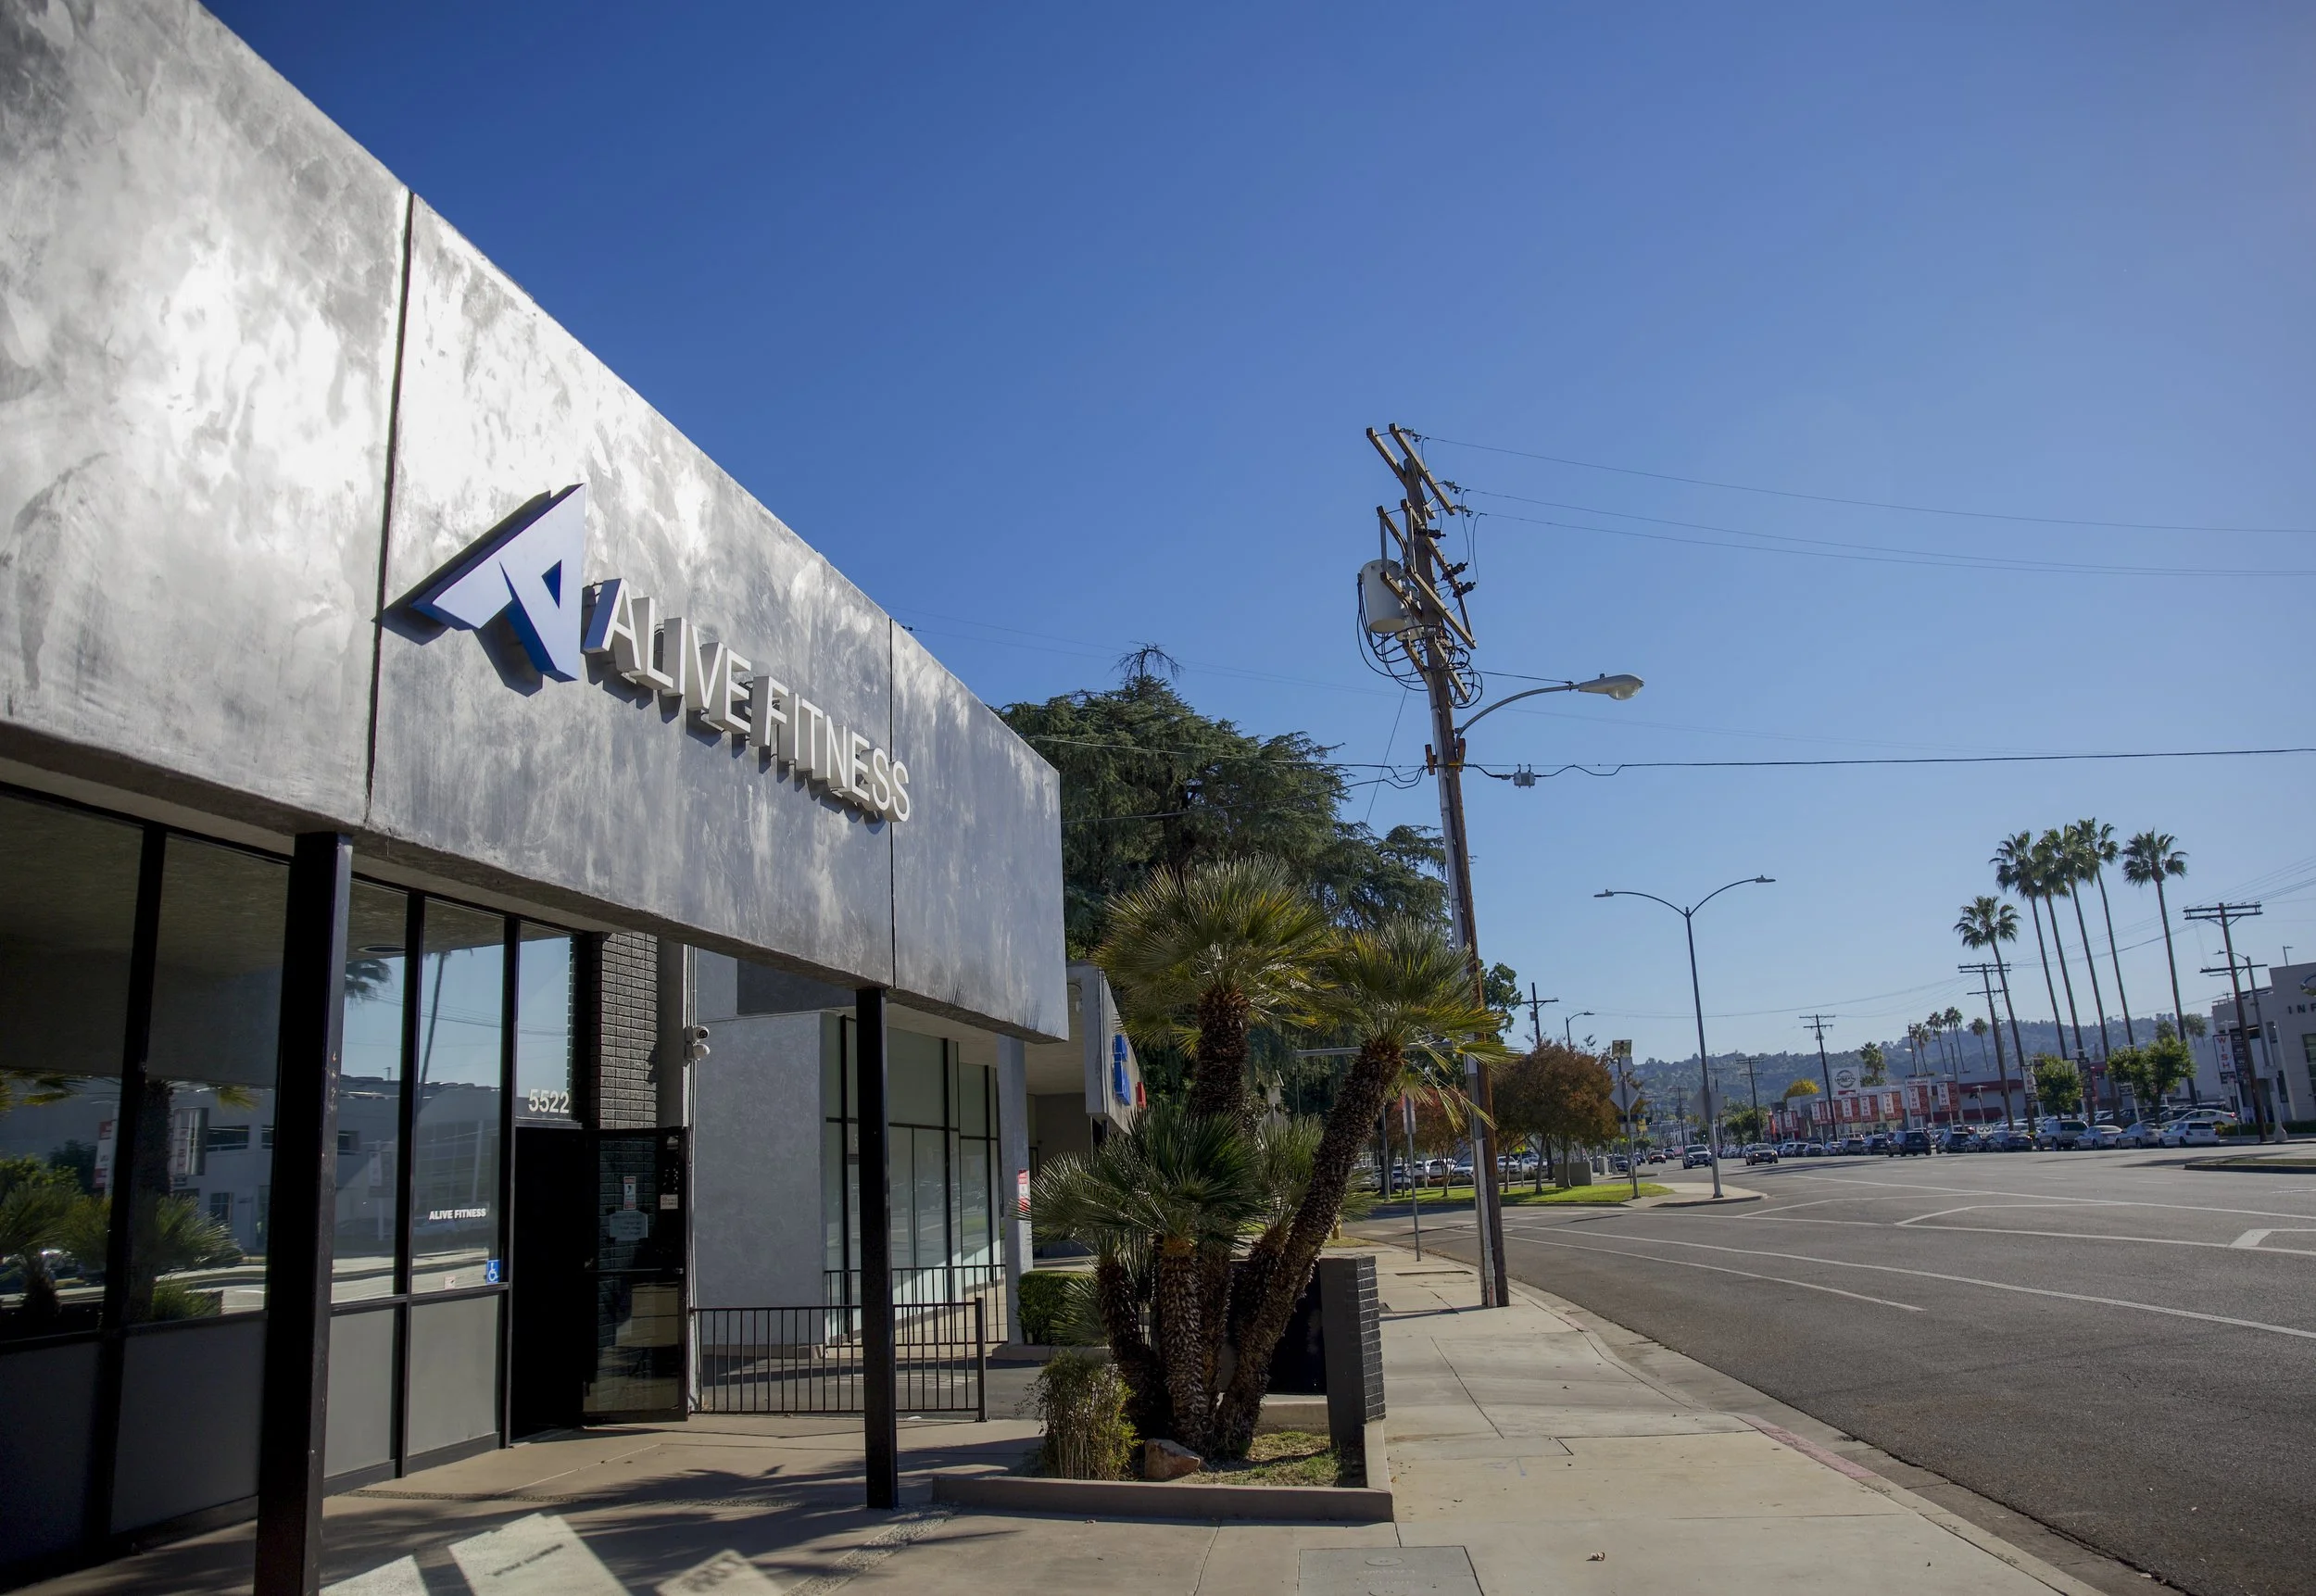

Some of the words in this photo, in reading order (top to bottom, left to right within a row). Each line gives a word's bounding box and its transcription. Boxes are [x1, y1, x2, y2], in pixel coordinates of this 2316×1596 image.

[585, 578, 751, 733] ALIVE
[751, 675, 911, 823] FITNESS
[528, 1088, 570, 1113] 5522
[429, 1210, 454, 1220] ALIVE
[454, 1208, 486, 1219] FITNESS
